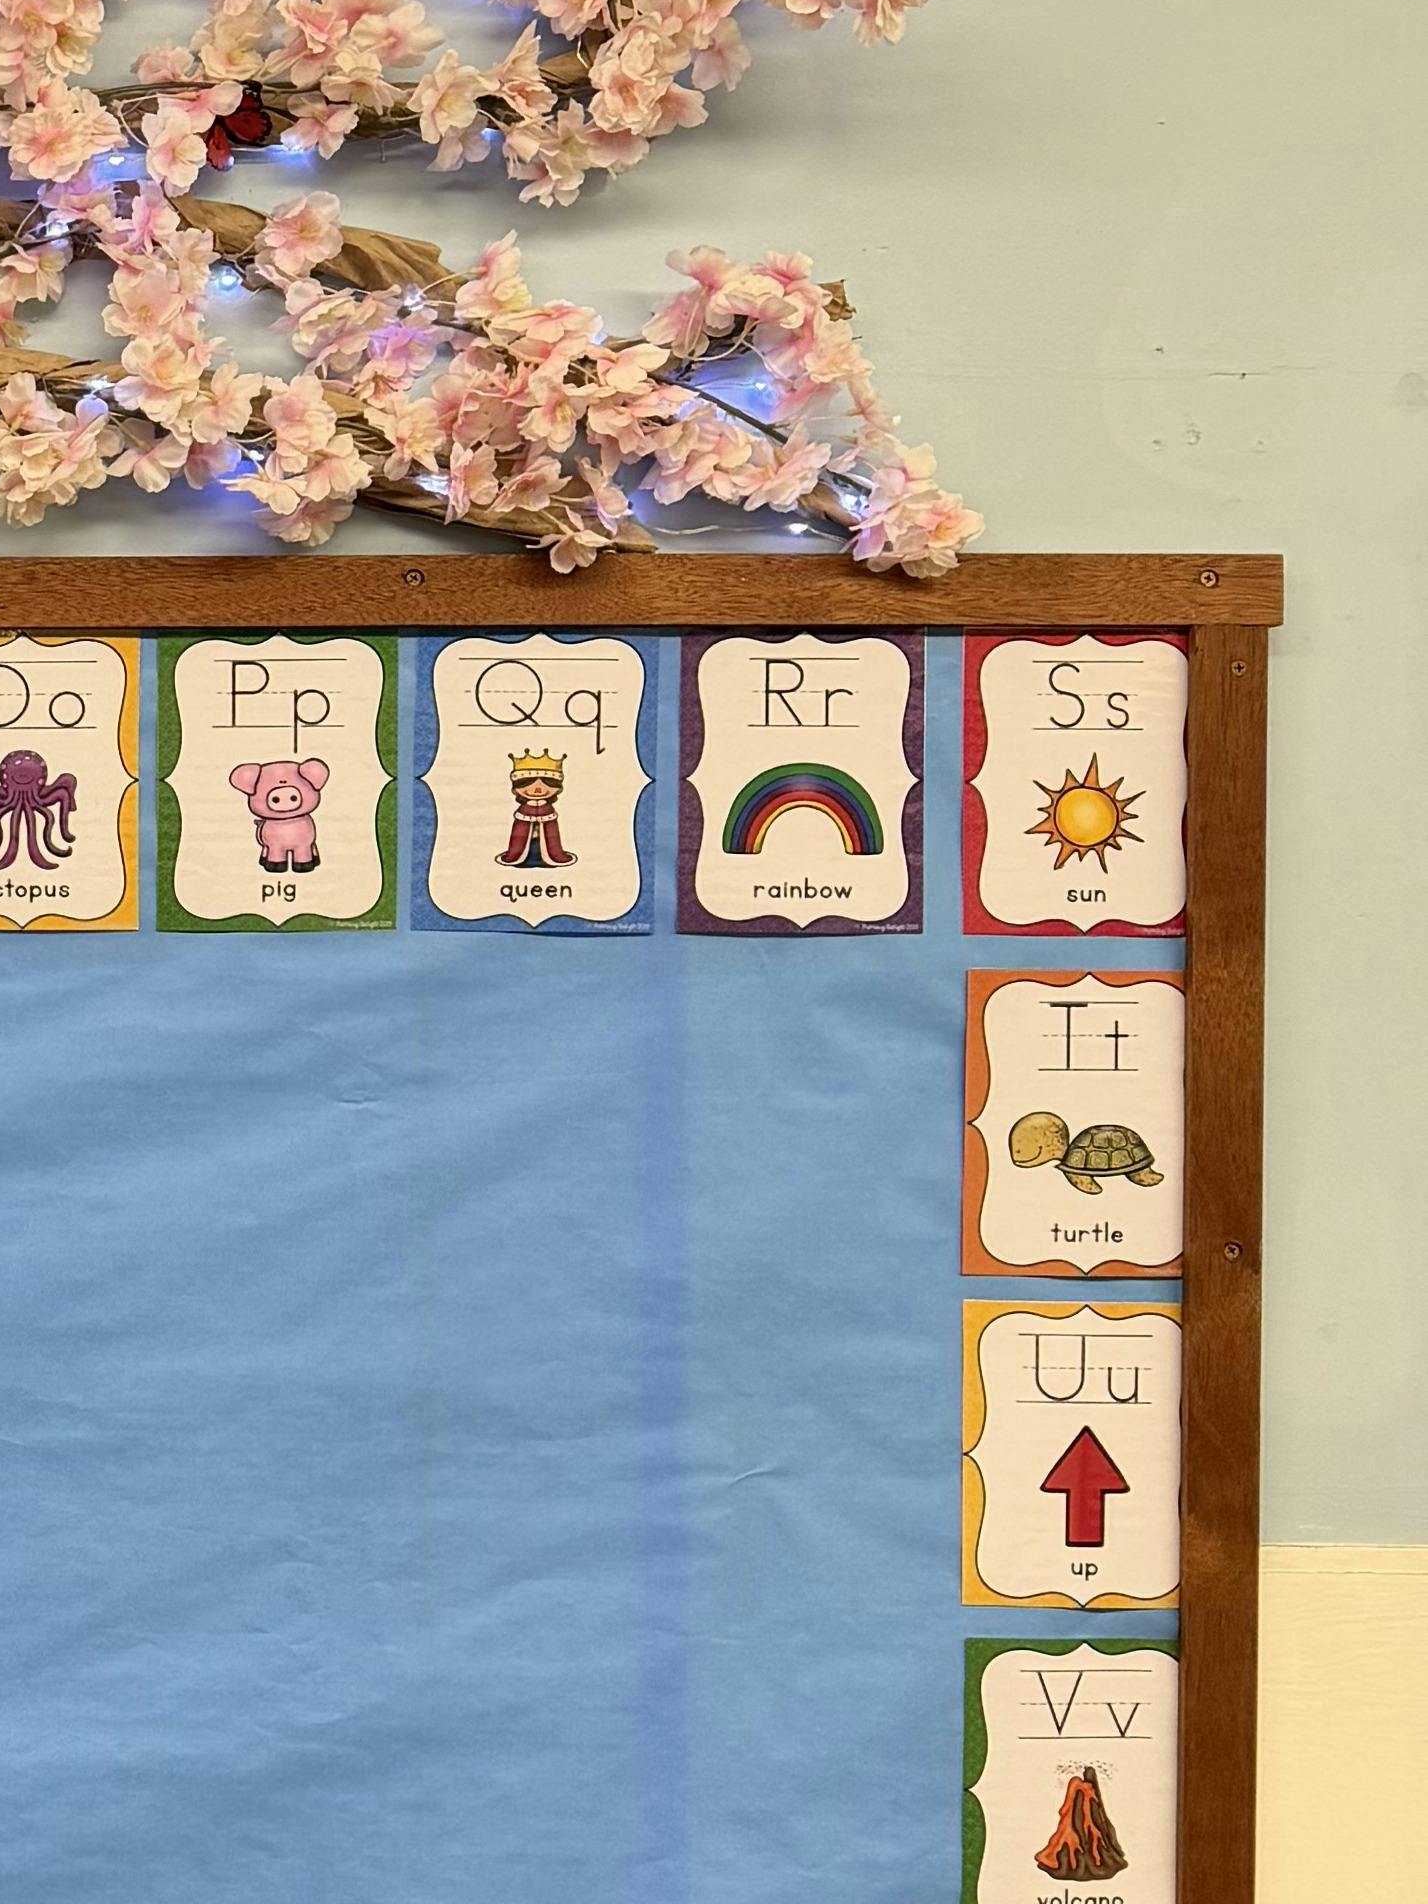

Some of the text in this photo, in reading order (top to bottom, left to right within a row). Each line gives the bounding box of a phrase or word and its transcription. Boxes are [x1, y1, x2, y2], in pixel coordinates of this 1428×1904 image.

[231, 660, 331, 753] Pp
[475, 659, 605, 754] Qq
[764, 659, 853, 727] Rr
[1047, 662, 1129, 729] Ss
[260, 879, 297, 904] pig
[499, 883, 574, 904] queen
[752, 876, 854, 900] rainbow
[1065, 888, 1108, 904] sun
[1050, 1002, 1129, 1070] Tt
[1049, 1220, 1125, 1245] turtle
[1036, 1335, 1139, 1404] Uu
[1070, 1561, 1100, 1582] up
[1037, 1670, 1140, 1738] Vv
